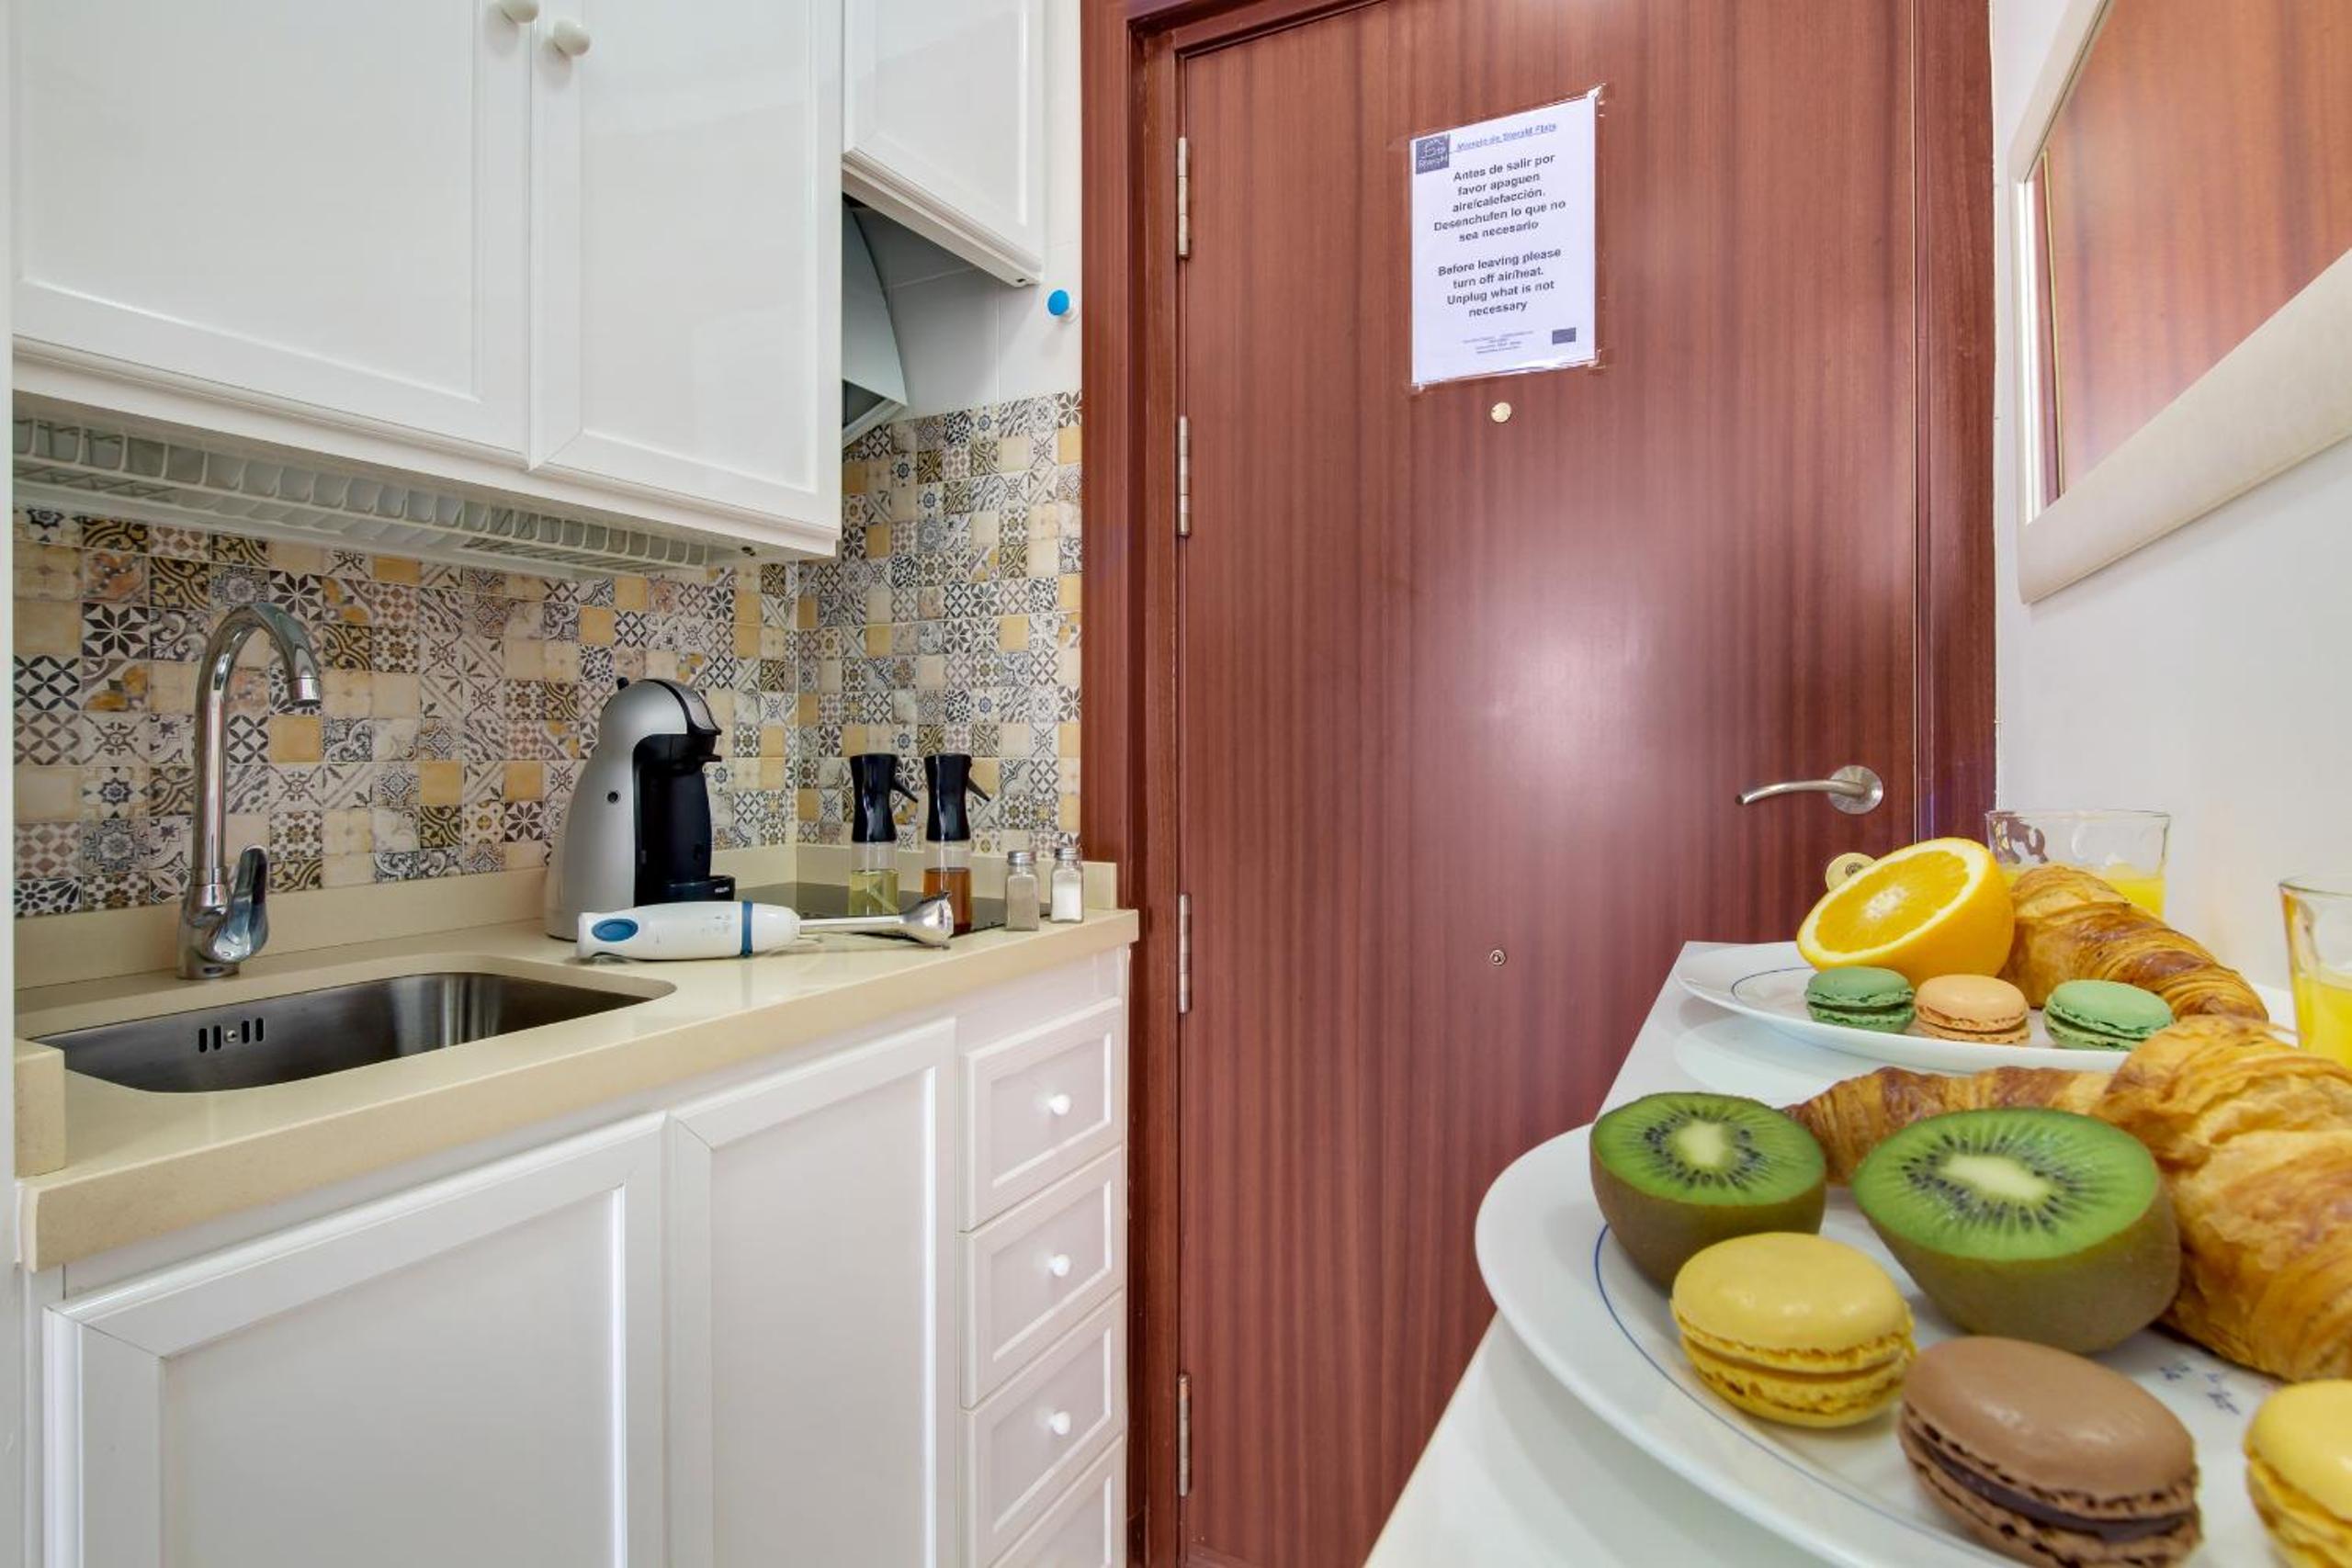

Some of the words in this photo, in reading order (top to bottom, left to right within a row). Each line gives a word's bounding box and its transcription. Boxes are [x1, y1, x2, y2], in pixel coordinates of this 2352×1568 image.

[1453, 169, 1486, 182] Antes
[1489, 164, 1503, 175] de
[1507, 159, 1532, 172] salir
[1535, 154, 1556, 170] por
[1458, 184, 1487, 197] favor
[1490, 173, 1540, 191] apaguen
[1434, 211, 1507, 231] Desenchufen
[1511, 208, 1521, 217] lo
[1525, 204, 1547, 218] que
[1551, 200, 1566, 210] no
[1459, 231, 1478, 243] sea
[1482, 220, 1539, 238] necesario
[1439, 263, 1475, 276] Before
[1477, 255, 1519, 272] leaving
[1522, 248, 1562, 264] please
[1453, 277, 1476, 289] turn
[1479, 273, 1494, 284] off
[1498, 266, 1544, 281] air/heat.
[1447, 291, 1487, 306] Unplug
[1490, 287, 1519, 299] what
[1521, 284, 1532, 294] is
[1534, 280, 1555, 291] not
[1468, 301, 1528, 318] necessary
